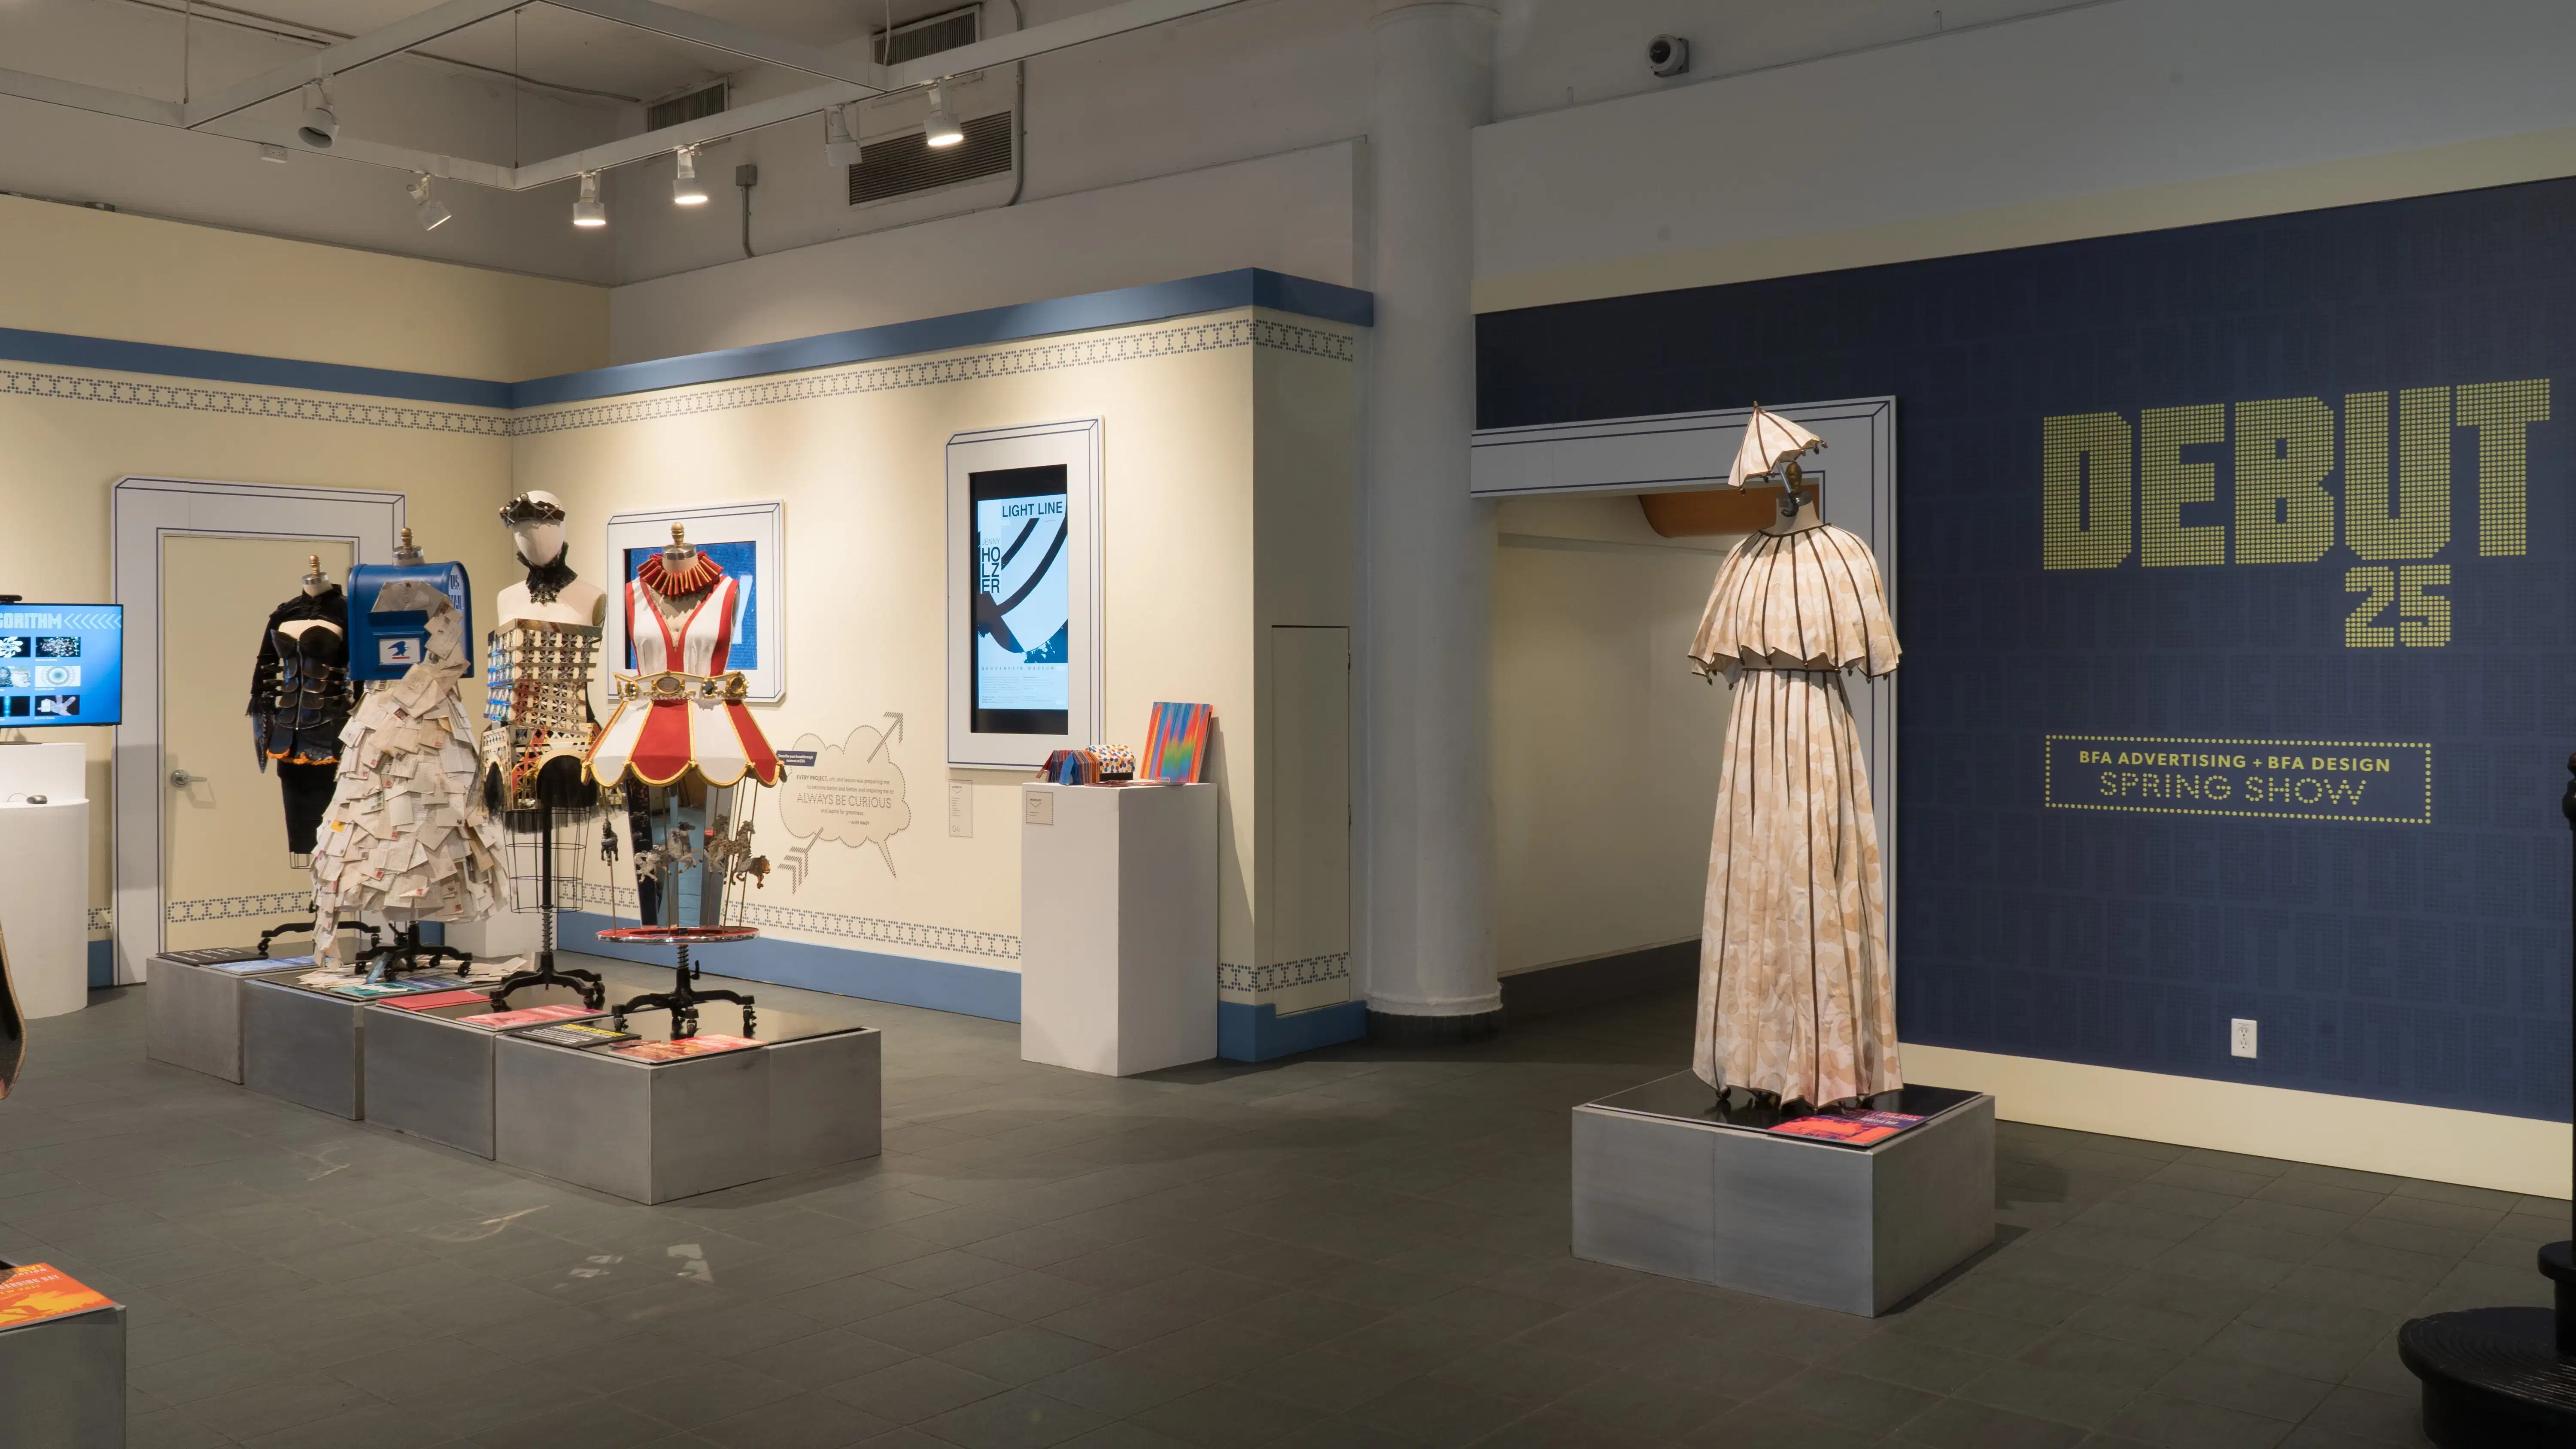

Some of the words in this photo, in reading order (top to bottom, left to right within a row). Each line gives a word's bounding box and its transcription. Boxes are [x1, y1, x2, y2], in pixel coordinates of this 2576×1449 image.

[2043, 378, 2550, 570] DEBUT
[1002, 503, 1034, 517] LIGHT
[1038, 501, 1063, 515] LINE
[982, 546, 1000, 562] HO
[982, 562, 999, 578] LZ
[2345, 564, 2451, 647] 25
[2079, 751, 2111, 764] BFA
[2118, 752, 2246, 768] ADVERTISING
[2253, 758, 2263, 767] +
[2268, 756, 2304, 770] BFA
[2312, 757, 2390, 772] DESIGN
[2100, 771, 2232, 800] SPRING
[2245, 776, 2366, 806] SHOW
[796, 792, 833, 805] ALWAYS
[835, 795, 846, 806] BE
[848, 795, 891, 809] CURIOUS
